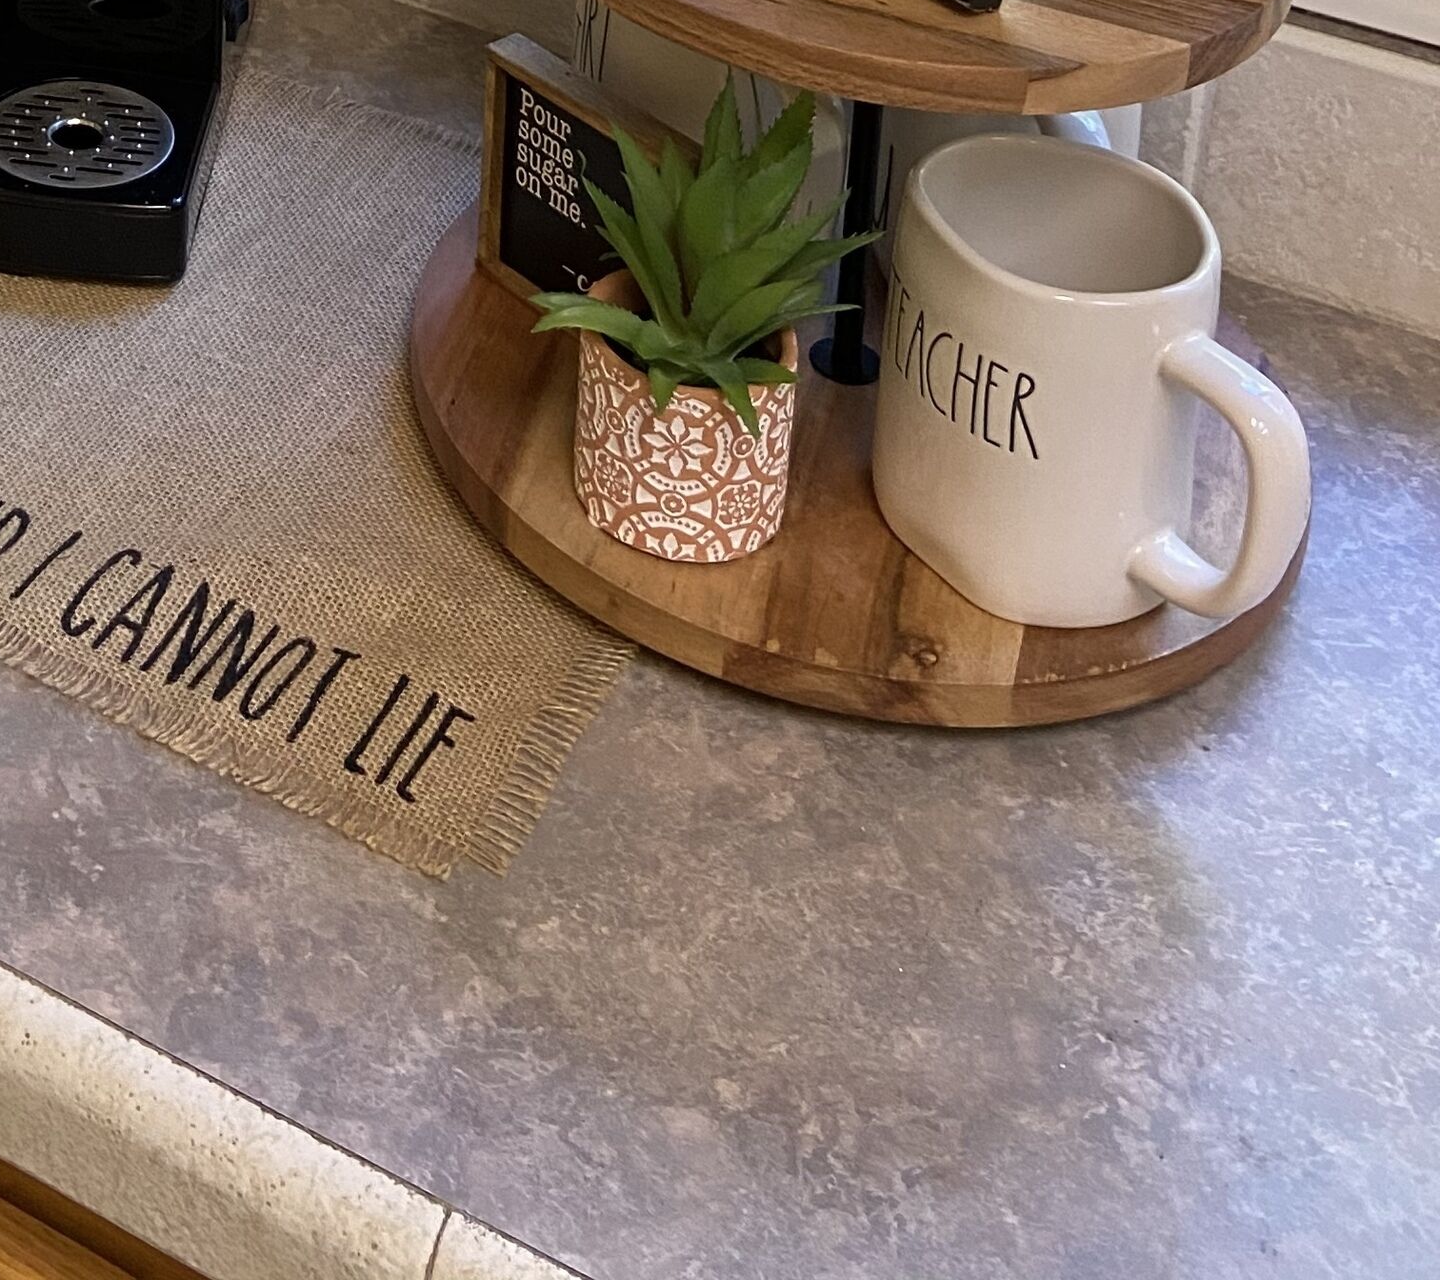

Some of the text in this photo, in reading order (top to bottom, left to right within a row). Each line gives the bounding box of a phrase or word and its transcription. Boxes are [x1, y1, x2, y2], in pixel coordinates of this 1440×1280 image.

[518, 119, 574, 169] some
[519, 87, 572, 142] Pour
[515, 166, 587, 229] on me.
[517, 143, 579, 196] sugar
[887, 263, 1039, 460] TEACHER
[9, 530, 83, 600] I
[60, 548, 362, 743] CANNOT
[343, 673, 475, 803] LIE
